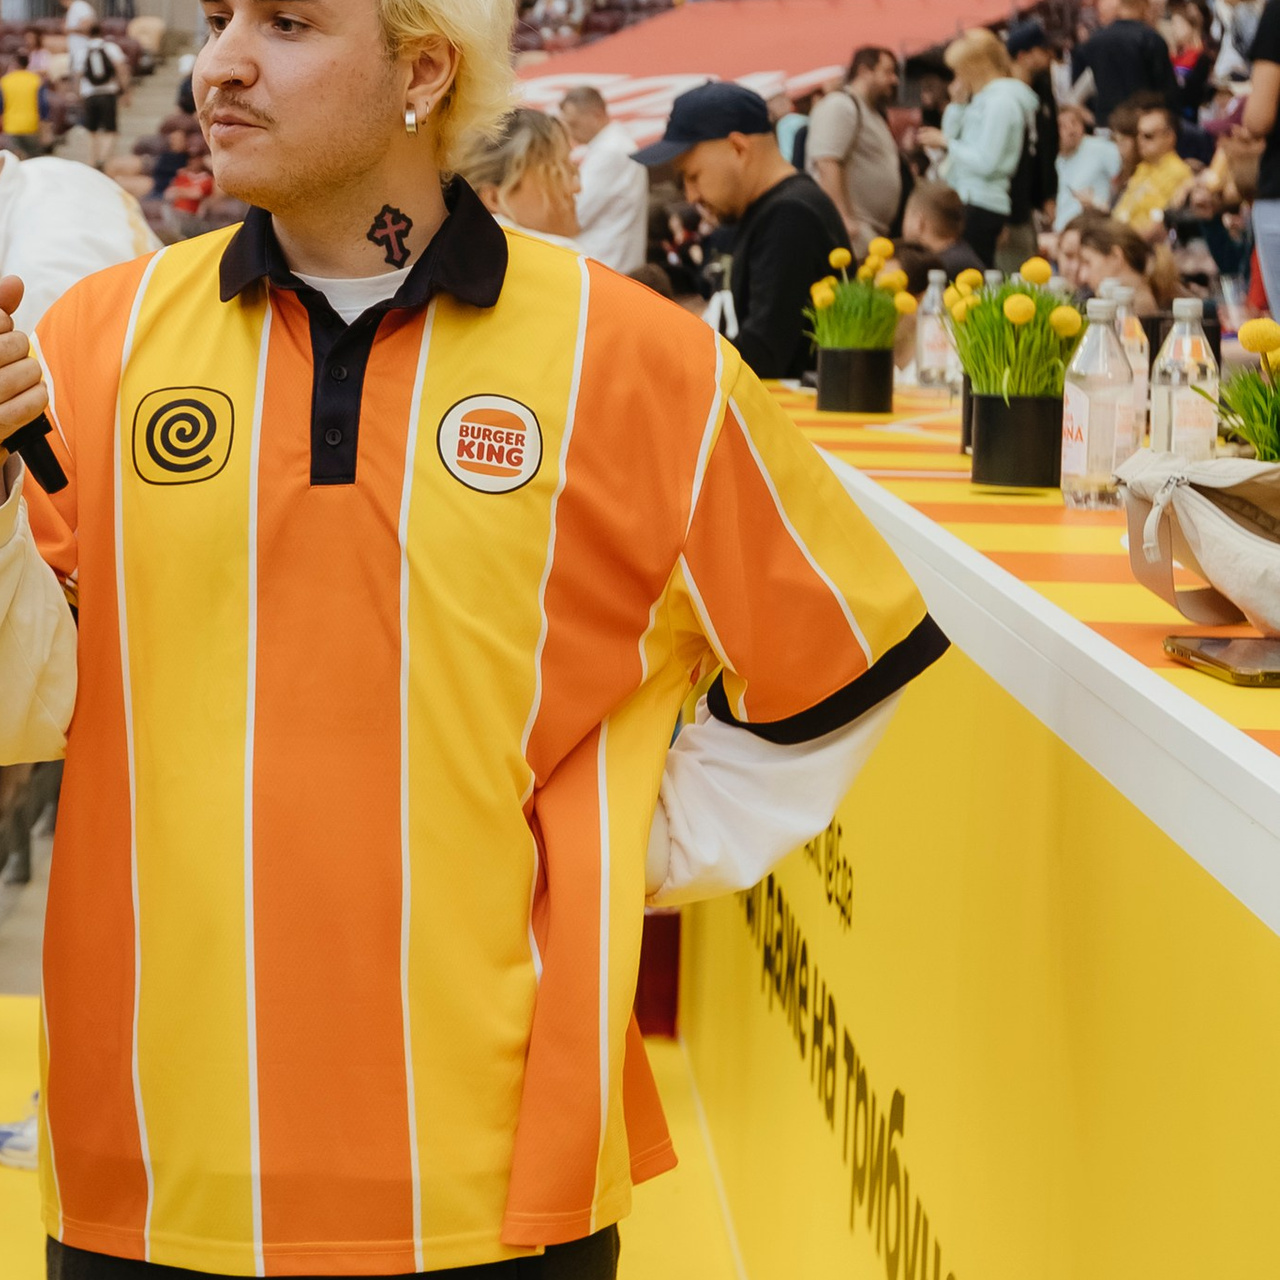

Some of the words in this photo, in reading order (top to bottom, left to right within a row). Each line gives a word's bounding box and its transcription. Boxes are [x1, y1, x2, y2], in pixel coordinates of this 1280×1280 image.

[459, 424, 526, 447] BURGER
[456, 438, 524, 467] KING
[811, 964, 837, 1133] на
